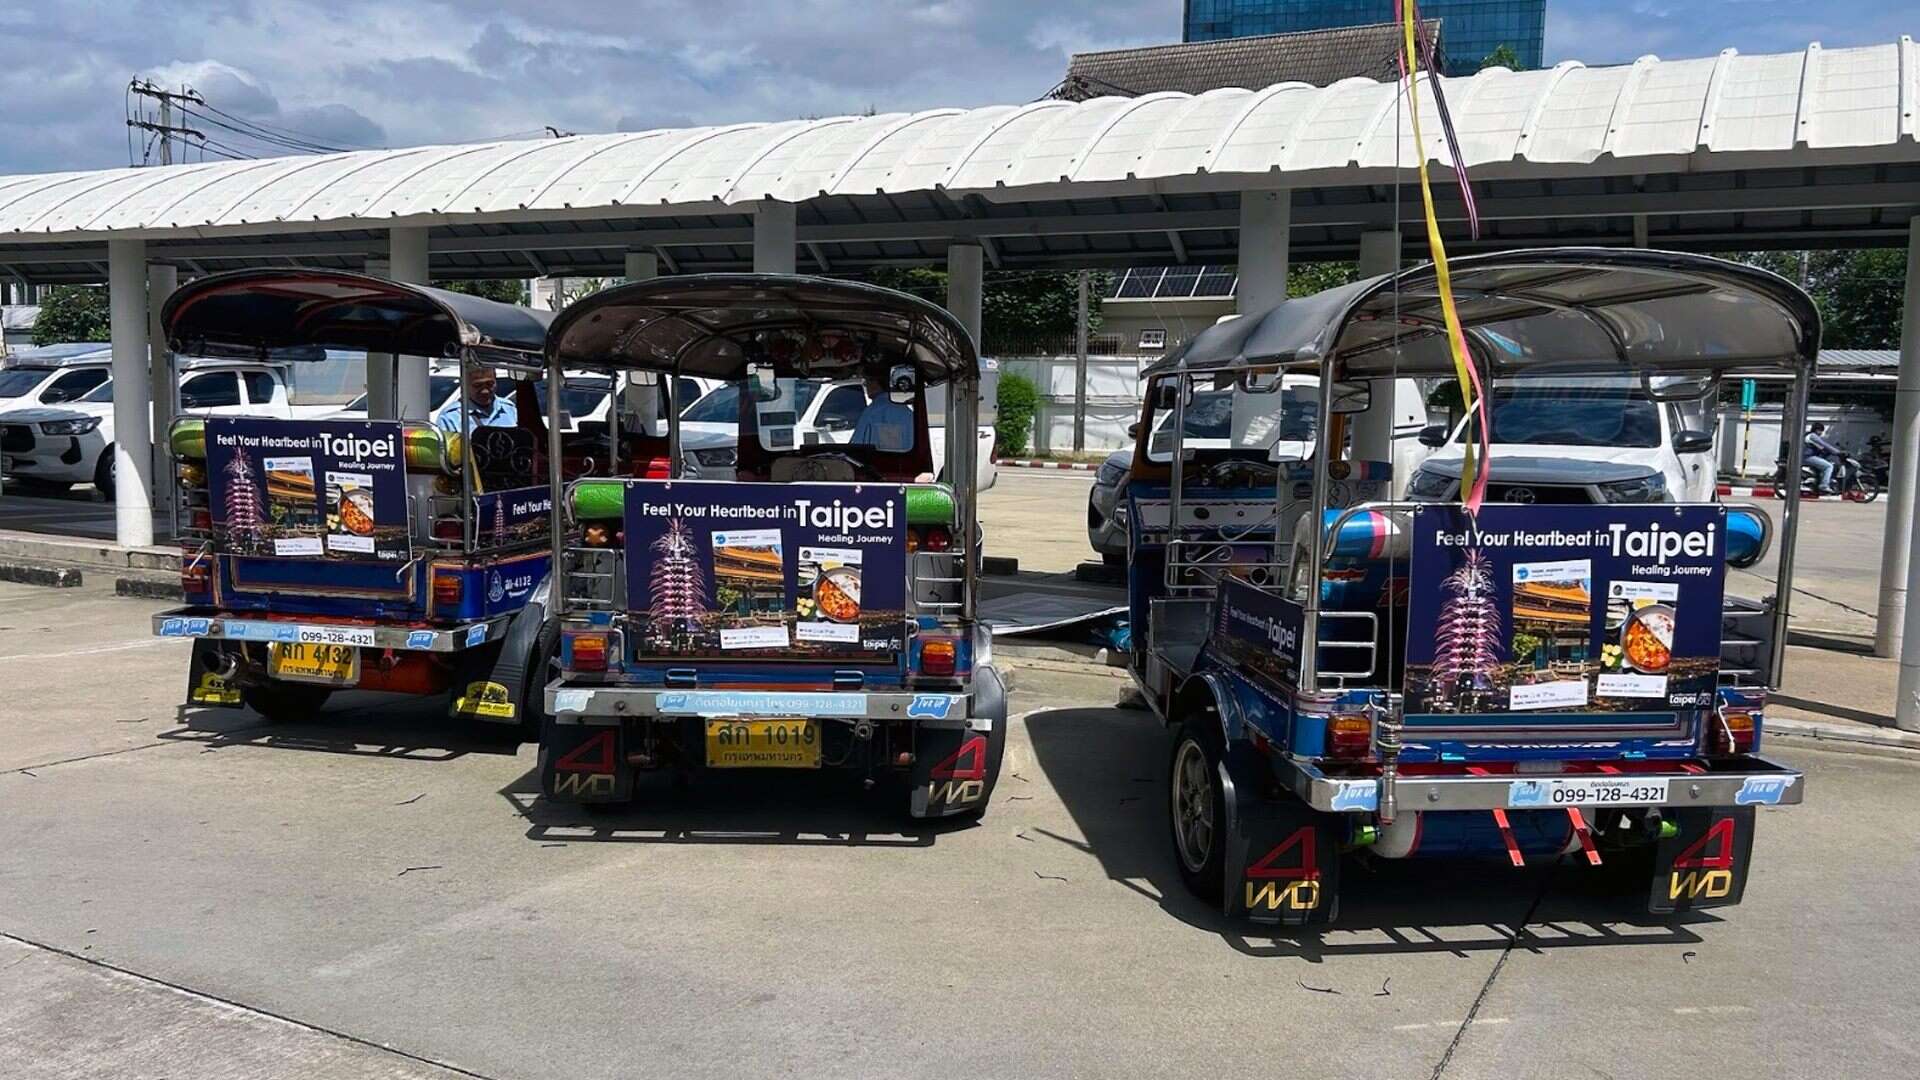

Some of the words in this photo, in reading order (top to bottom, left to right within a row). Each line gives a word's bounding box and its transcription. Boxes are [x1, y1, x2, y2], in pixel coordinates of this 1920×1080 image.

[217, 434, 236, 446] Feel
[238, 435, 260, 447] Your
[262, 436, 311, 449] Heartbeat
[312, 437, 322, 448] in
[320, 433, 395, 461] Taipei
[339, 461, 365, 471] Healing
[367, 462, 395, 472] Journey
[513, 503, 527, 516] Feel
[528, 501, 543, 513] Your
[643, 503, 671, 517] Feel
[675, 503, 706, 517] Your
[711, 504, 780, 519] Heartbeat
[783, 505, 797, 519] in
[795, 499, 895, 535] Taipei
[818, 533, 855, 545] Healing
[856, 534, 893, 545] Journey
[1436, 530, 1470, 547] Feel
[1475, 530, 1509, 547] Your
[1514, 530, 1591, 547] Heartbeat
[1595, 531, 1611, 547] in
[1608, 523, 1716, 564] Taipei
[1632, 565, 1671, 577] Healing
[1672, 565, 1712, 577] Journey
[301, 631, 373, 645] 099-128-4321
[1268, 616, 1298, 650] Taipei
[1669, 693, 1697, 707] taipei
[764, 724, 815, 745] 1019
[555, 728, 617, 774] 4
[930, 735, 987, 781] 4
[1553, 787, 1666, 803] 099-128-4321
[1246, 825, 1321, 879] 4
[1672, 817, 1735, 870] 4
